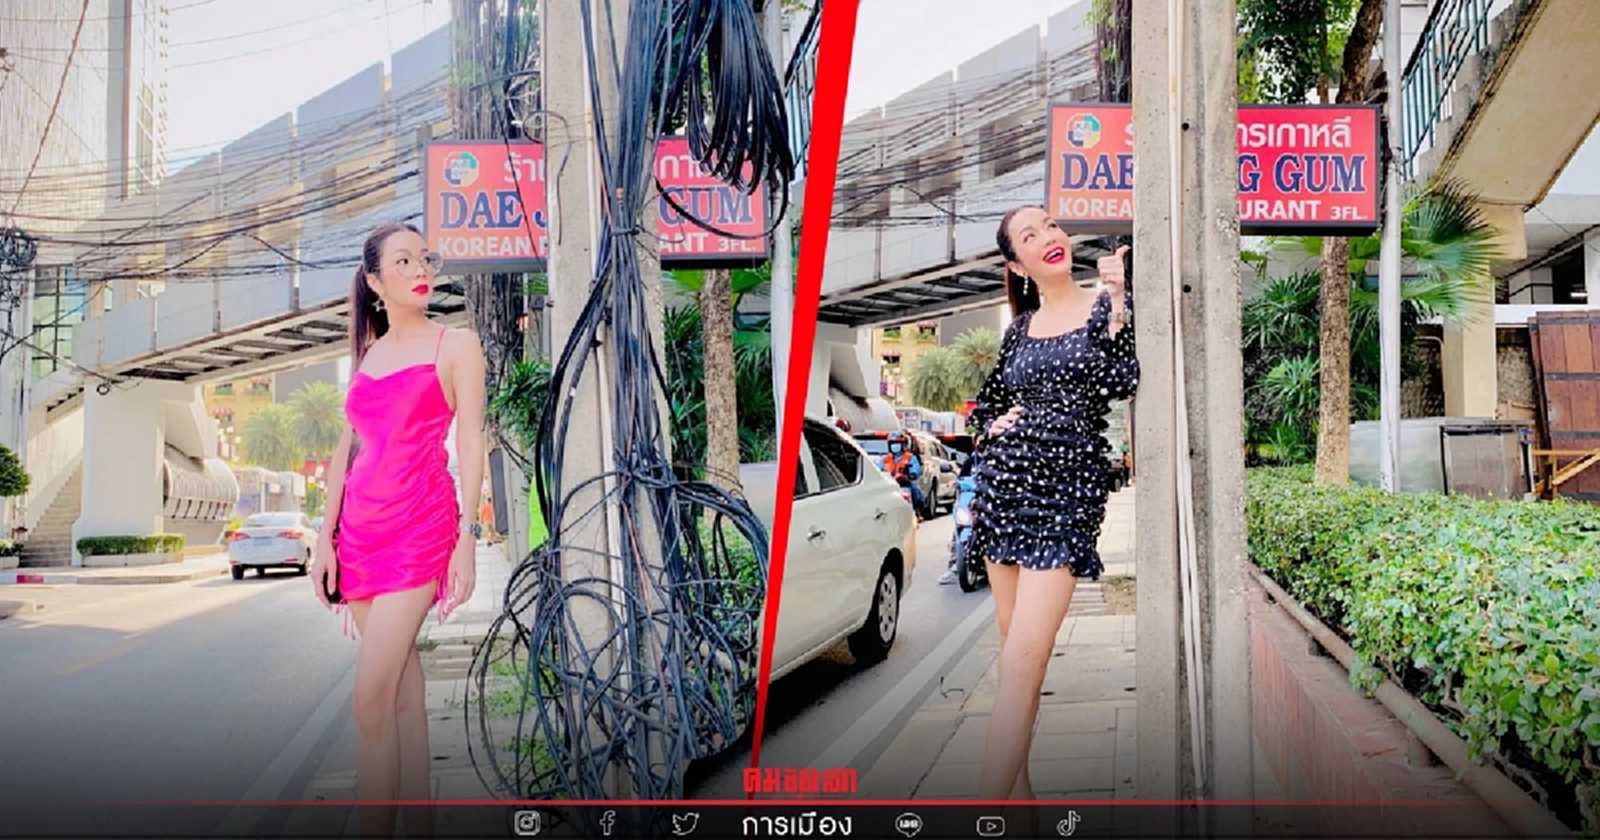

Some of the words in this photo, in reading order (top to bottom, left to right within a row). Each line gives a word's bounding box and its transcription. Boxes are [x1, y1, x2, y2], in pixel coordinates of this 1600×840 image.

[1237, 115, 1352, 148] ารเกาหลี
[1273, 153, 1368, 193] GUM
[438, 189, 523, 229] DAE
[659, 184, 754, 228] GUM
[1058, 196, 1133, 218] KOREA
[1239, 199, 1322, 220] URANT
[437, 236, 531, 256] KOREAN
[659, 232, 709, 252] ANT
